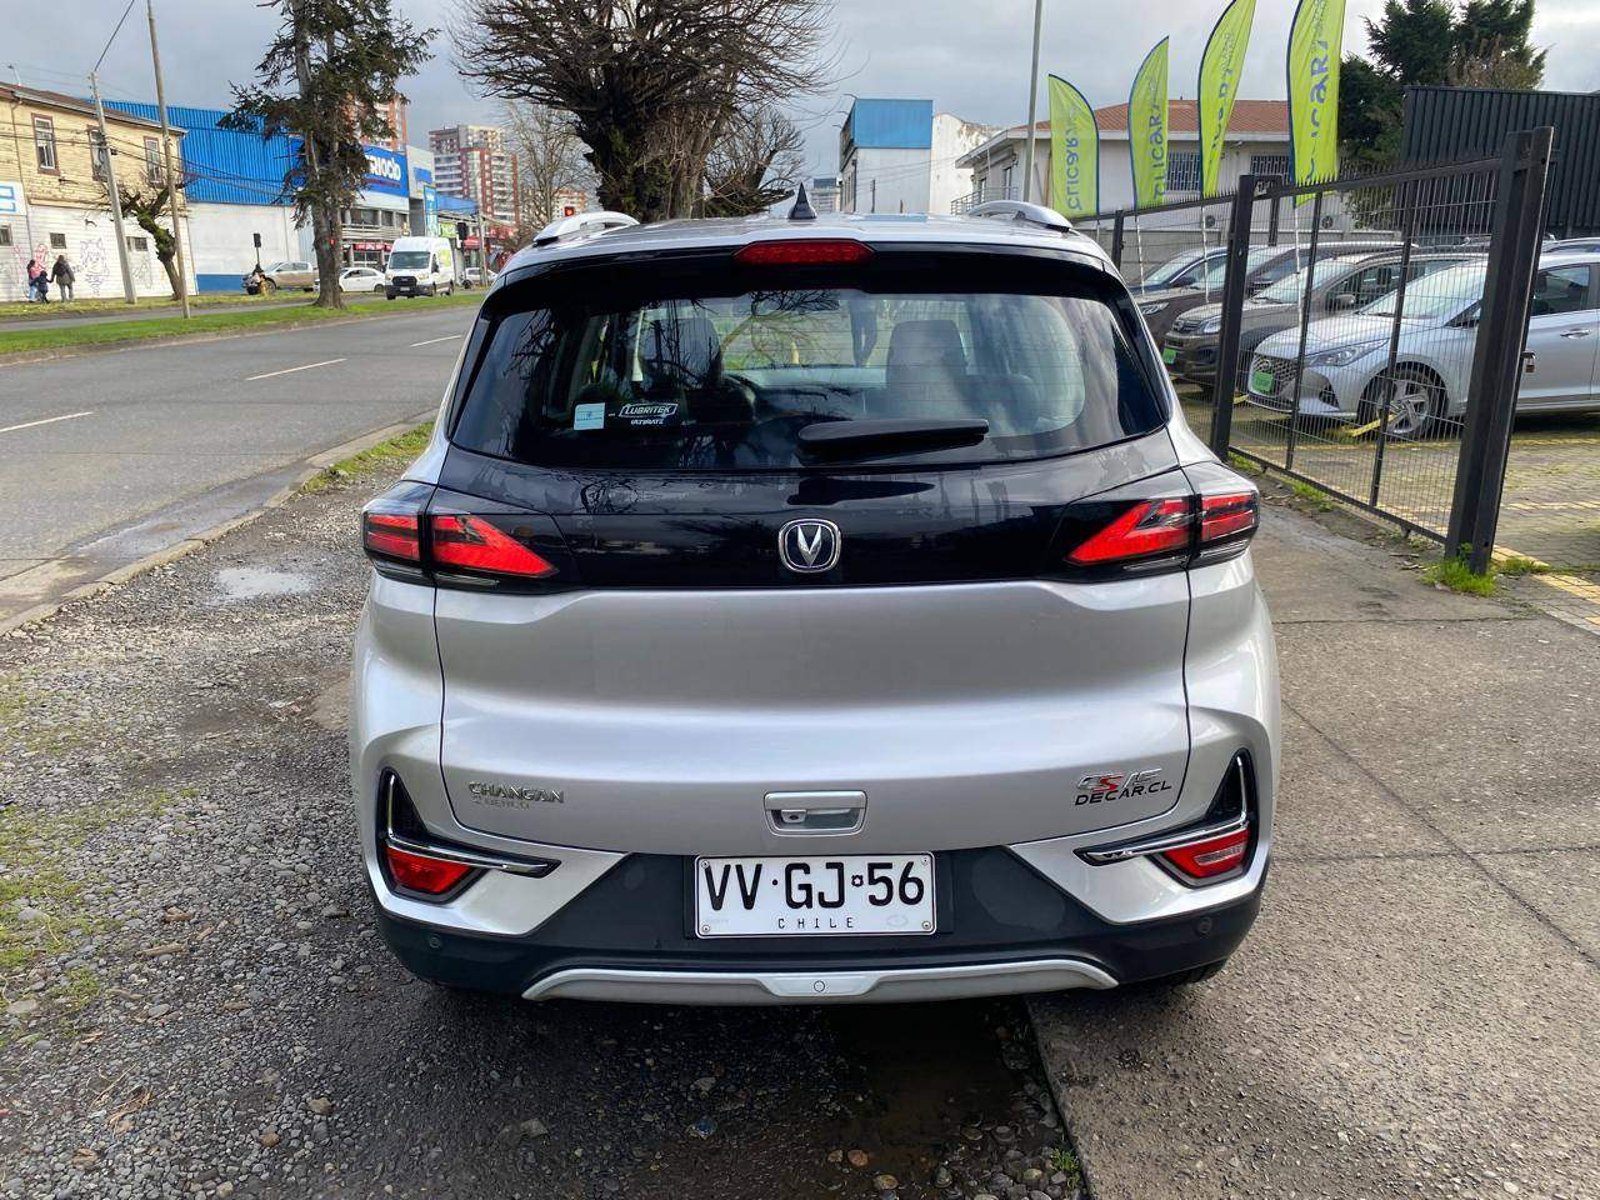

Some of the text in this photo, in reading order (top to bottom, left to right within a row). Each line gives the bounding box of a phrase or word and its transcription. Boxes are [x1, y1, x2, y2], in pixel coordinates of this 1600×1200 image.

[624, 405, 672, 416] LUBRITEK
[469, 781, 564, 804] CHANGAN
[1075, 780, 1172, 806] DECAR.CL
[778, 917, 854, 929] CHILE
